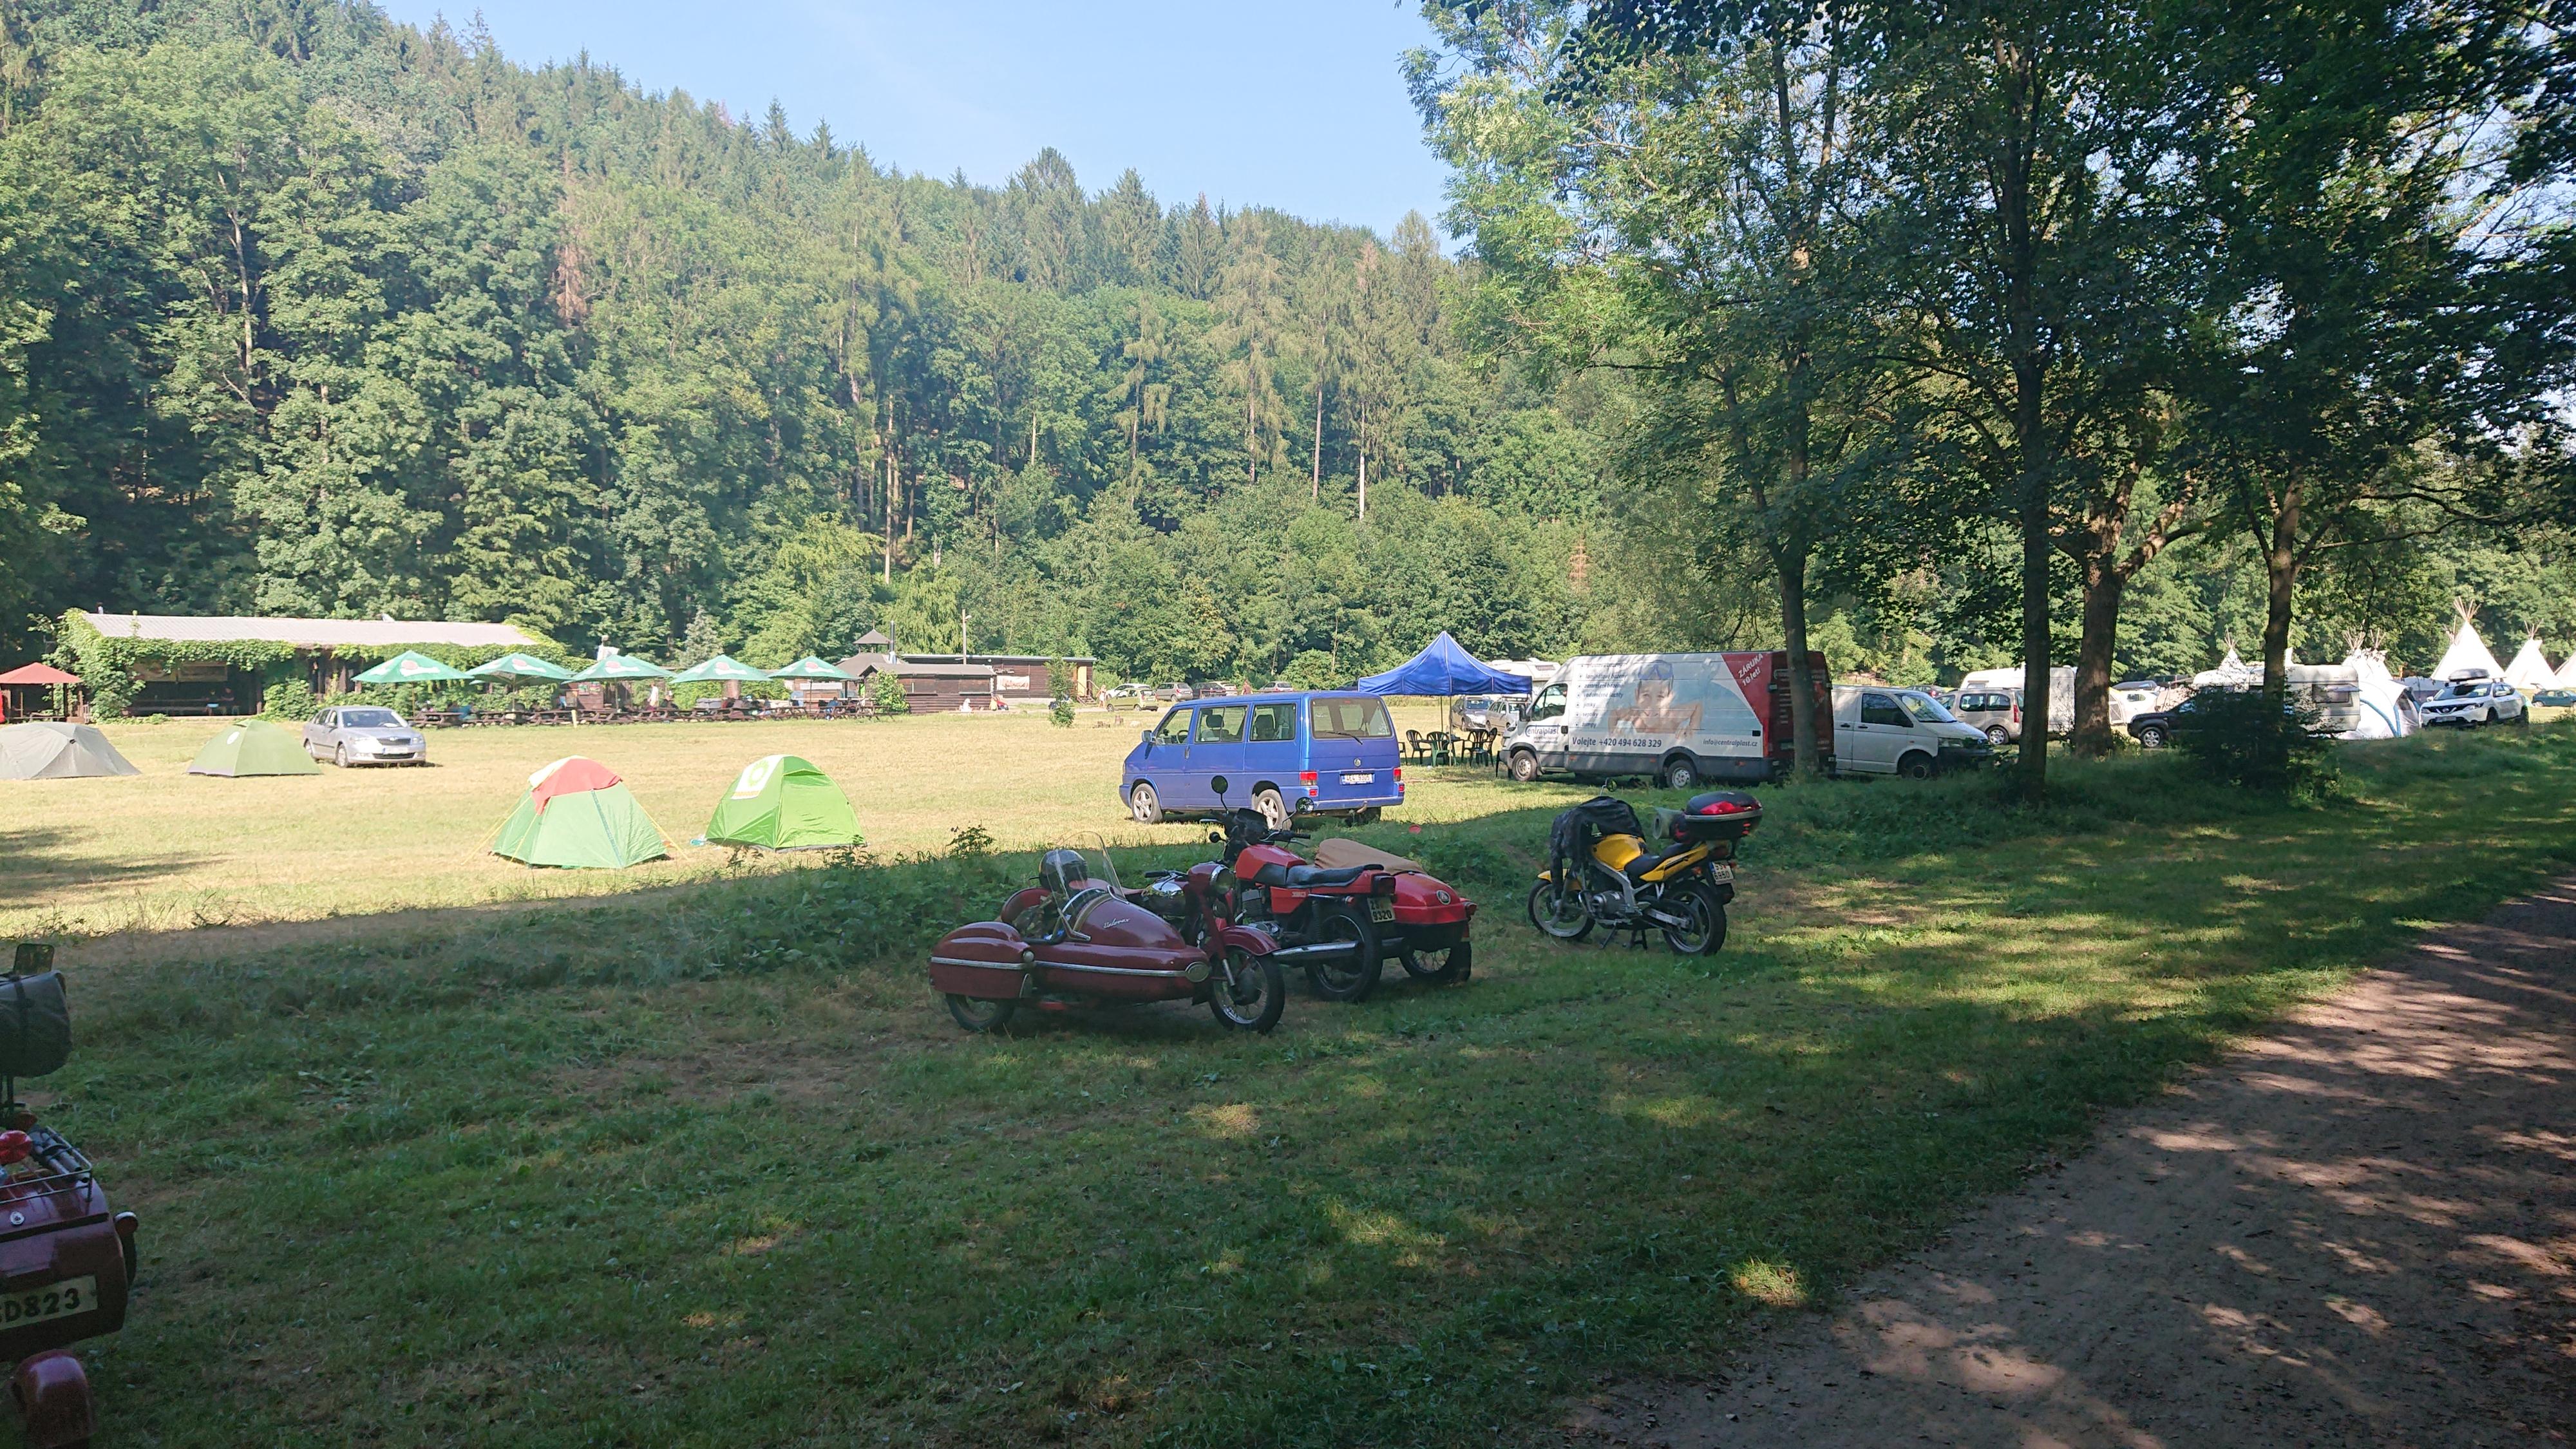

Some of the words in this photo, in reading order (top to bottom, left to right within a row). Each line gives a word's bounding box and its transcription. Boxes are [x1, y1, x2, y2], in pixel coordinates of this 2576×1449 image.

[1738, 653, 1763, 678] ZÁRUKA
[1742, 676, 1750, 686] 10
[1572, 736, 1596, 747] Volejte
[1598, 737, 1616, 746] +420
[1618, 738, 1631, 746] 494
[1633, 738, 1646, 747] 628
[1648, 739, 1662, 748] 329
[1703, 738, 1758, 748] info@centralplast.cz
[1714, 870, 1730, 880] 6950
[1372, 909, 1392, 920] 9320
[0, 1287, 80, 1323] D823
